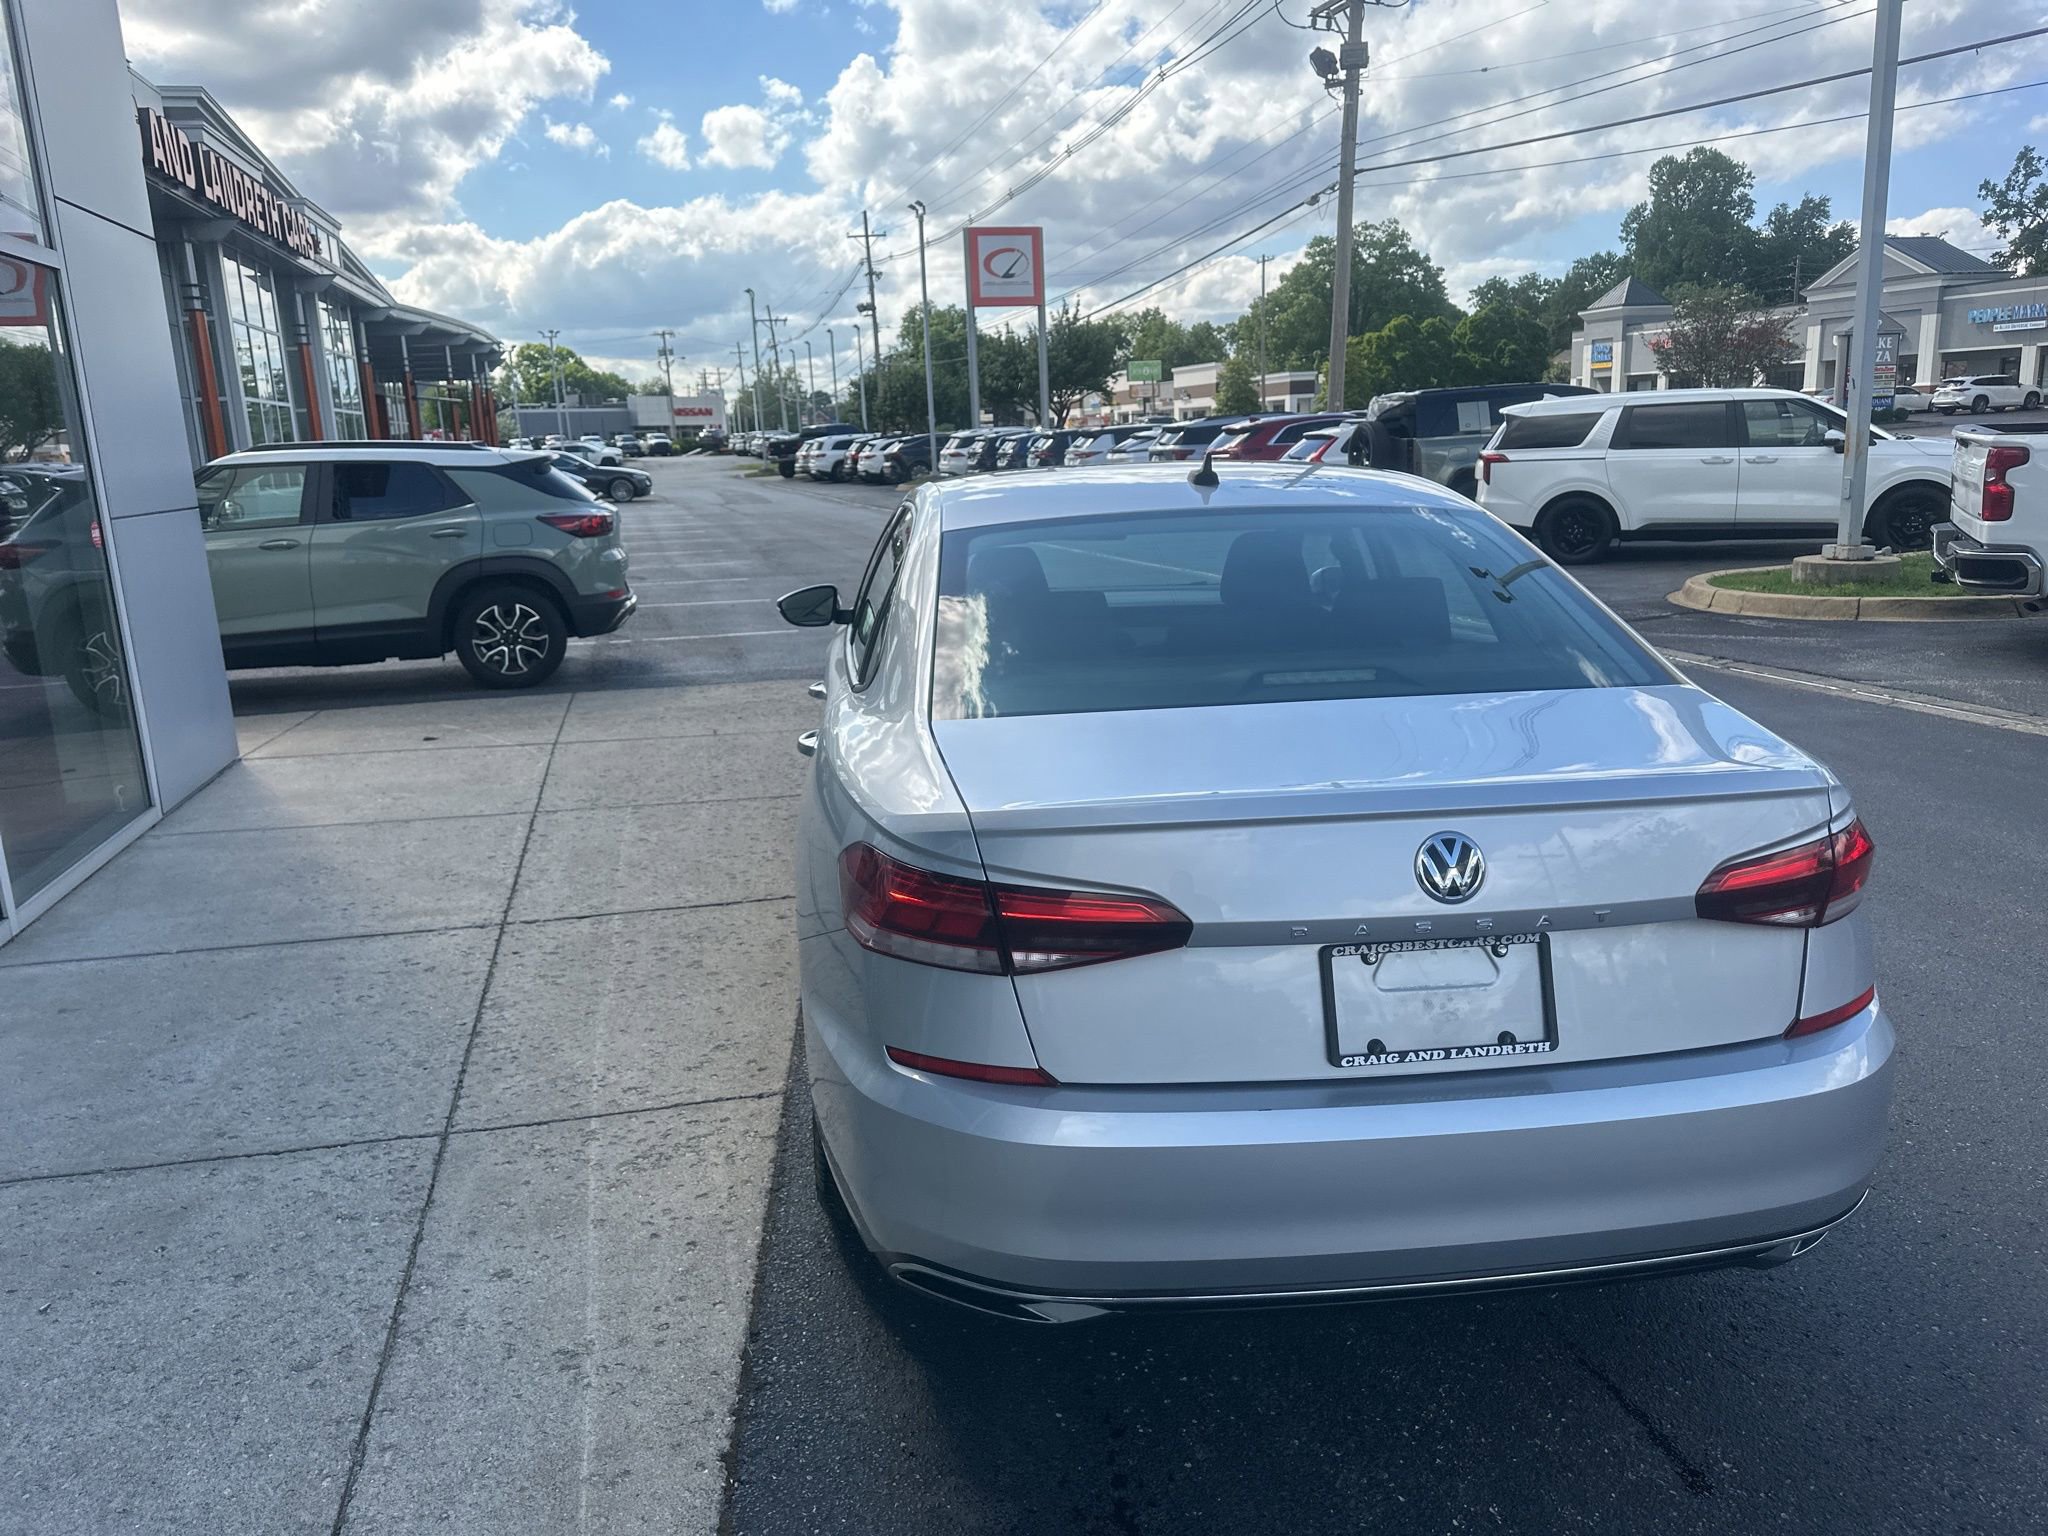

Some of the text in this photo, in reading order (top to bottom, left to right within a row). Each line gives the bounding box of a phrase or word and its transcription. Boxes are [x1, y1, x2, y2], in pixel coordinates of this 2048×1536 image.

[149, 107, 315, 260] AND LANDRETH CARS
[1876, 336, 1893, 349] KE
[1876, 350, 1891, 363] ZA
[673, 407, 713, 416] NISSAN
[1290, 909, 1611, 938] PASSAT
[1331, 932, 1541, 956] CRAIGSBESTCARS.COM
[1341, 1042, 1551, 1067] CRAIG AND LANDRETH
